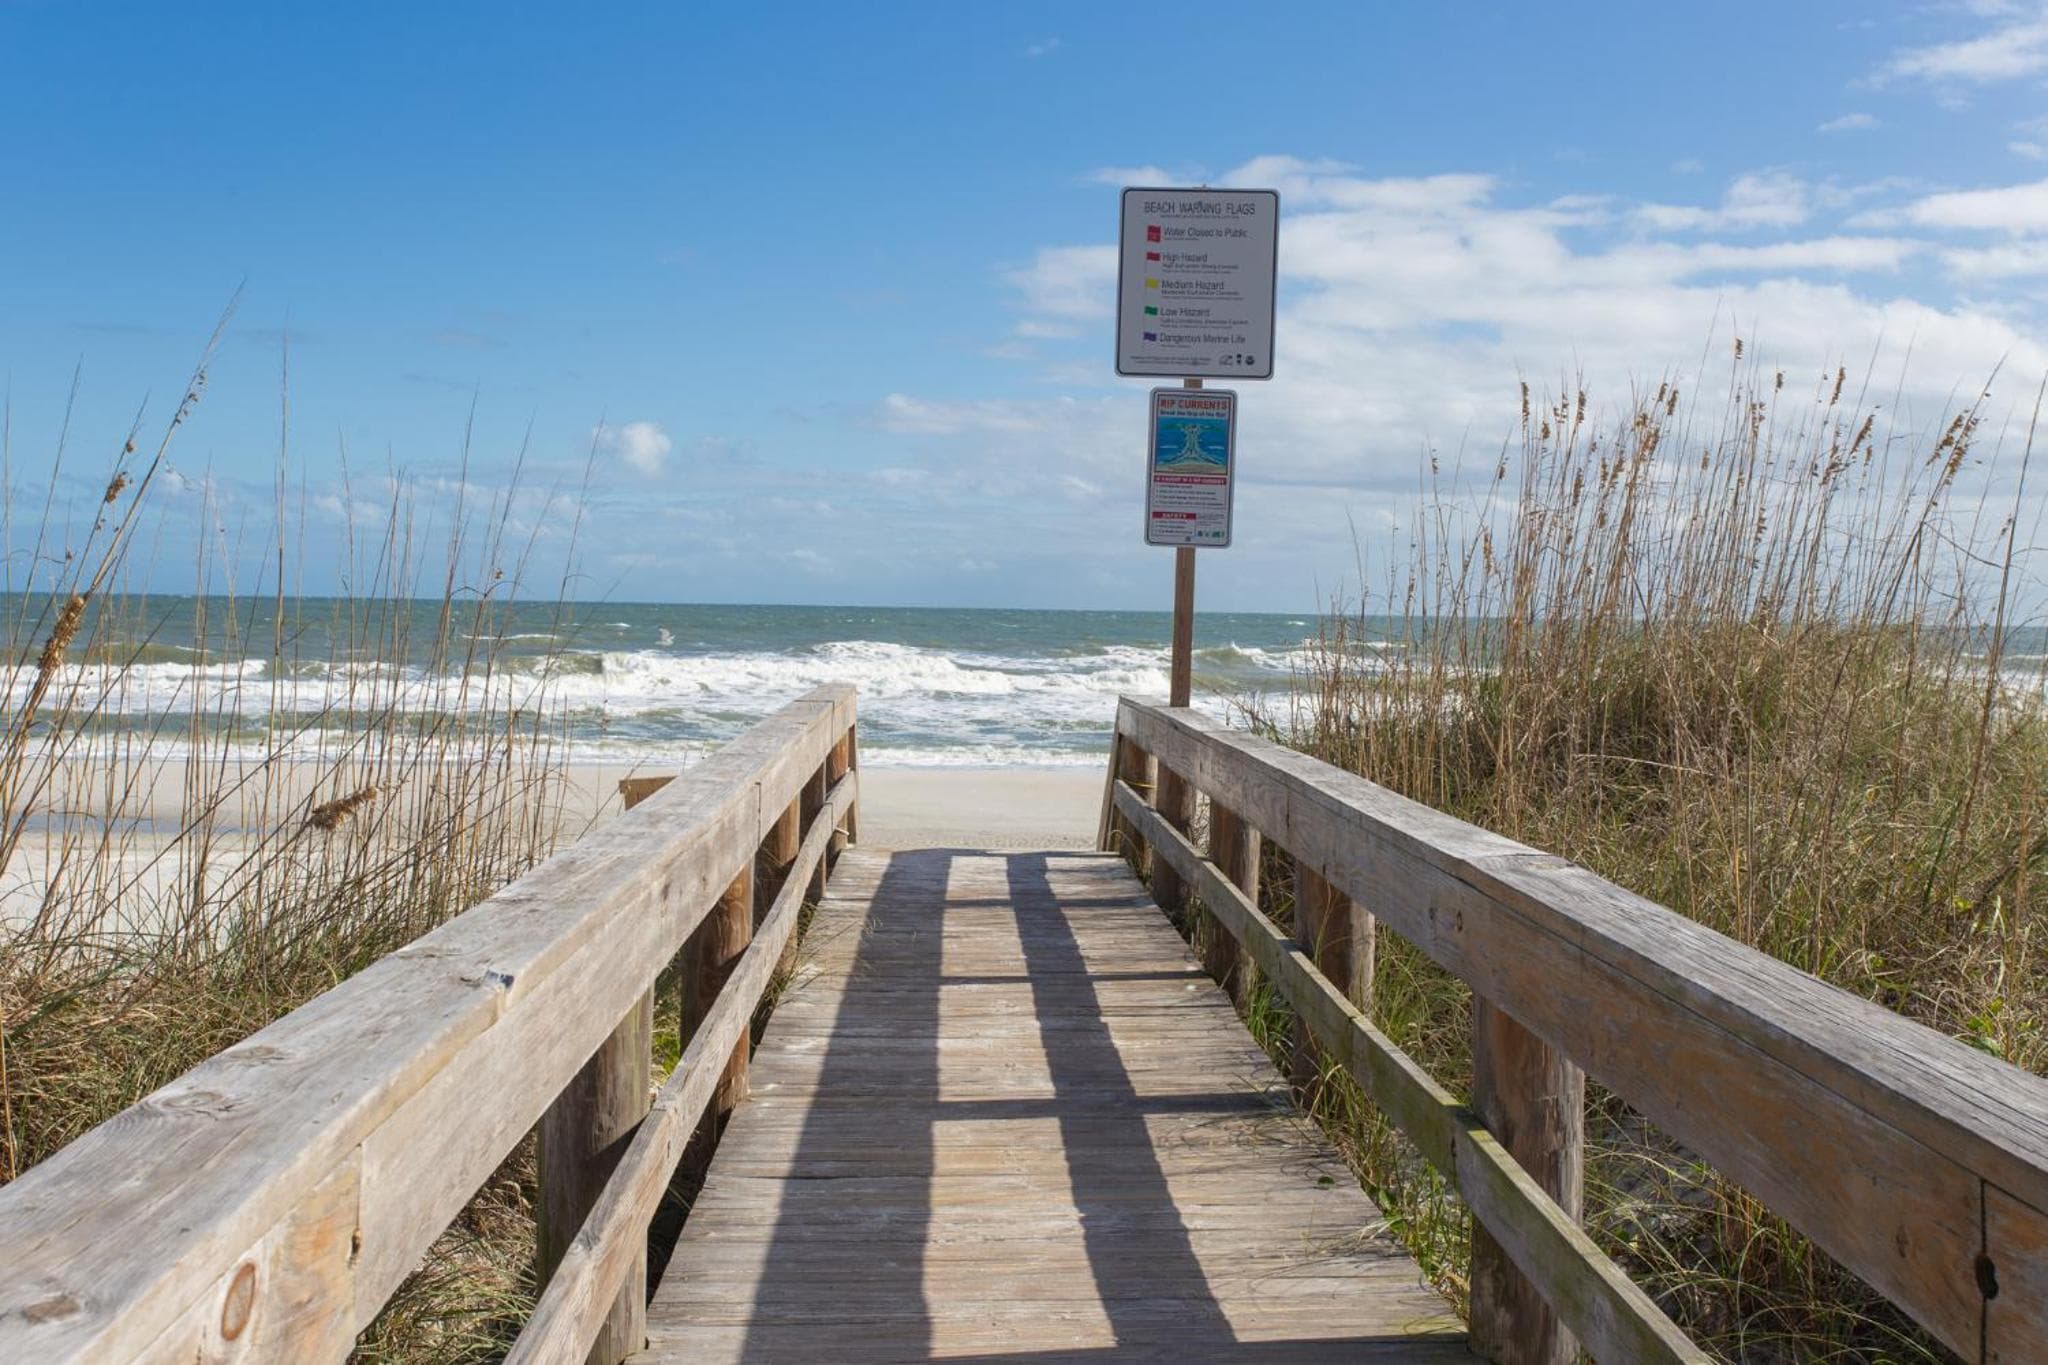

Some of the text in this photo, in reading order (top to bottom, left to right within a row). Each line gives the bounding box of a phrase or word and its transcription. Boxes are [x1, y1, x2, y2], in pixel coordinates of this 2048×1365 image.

[1144, 201, 1256, 216] BEACH WARNING FLAGS
